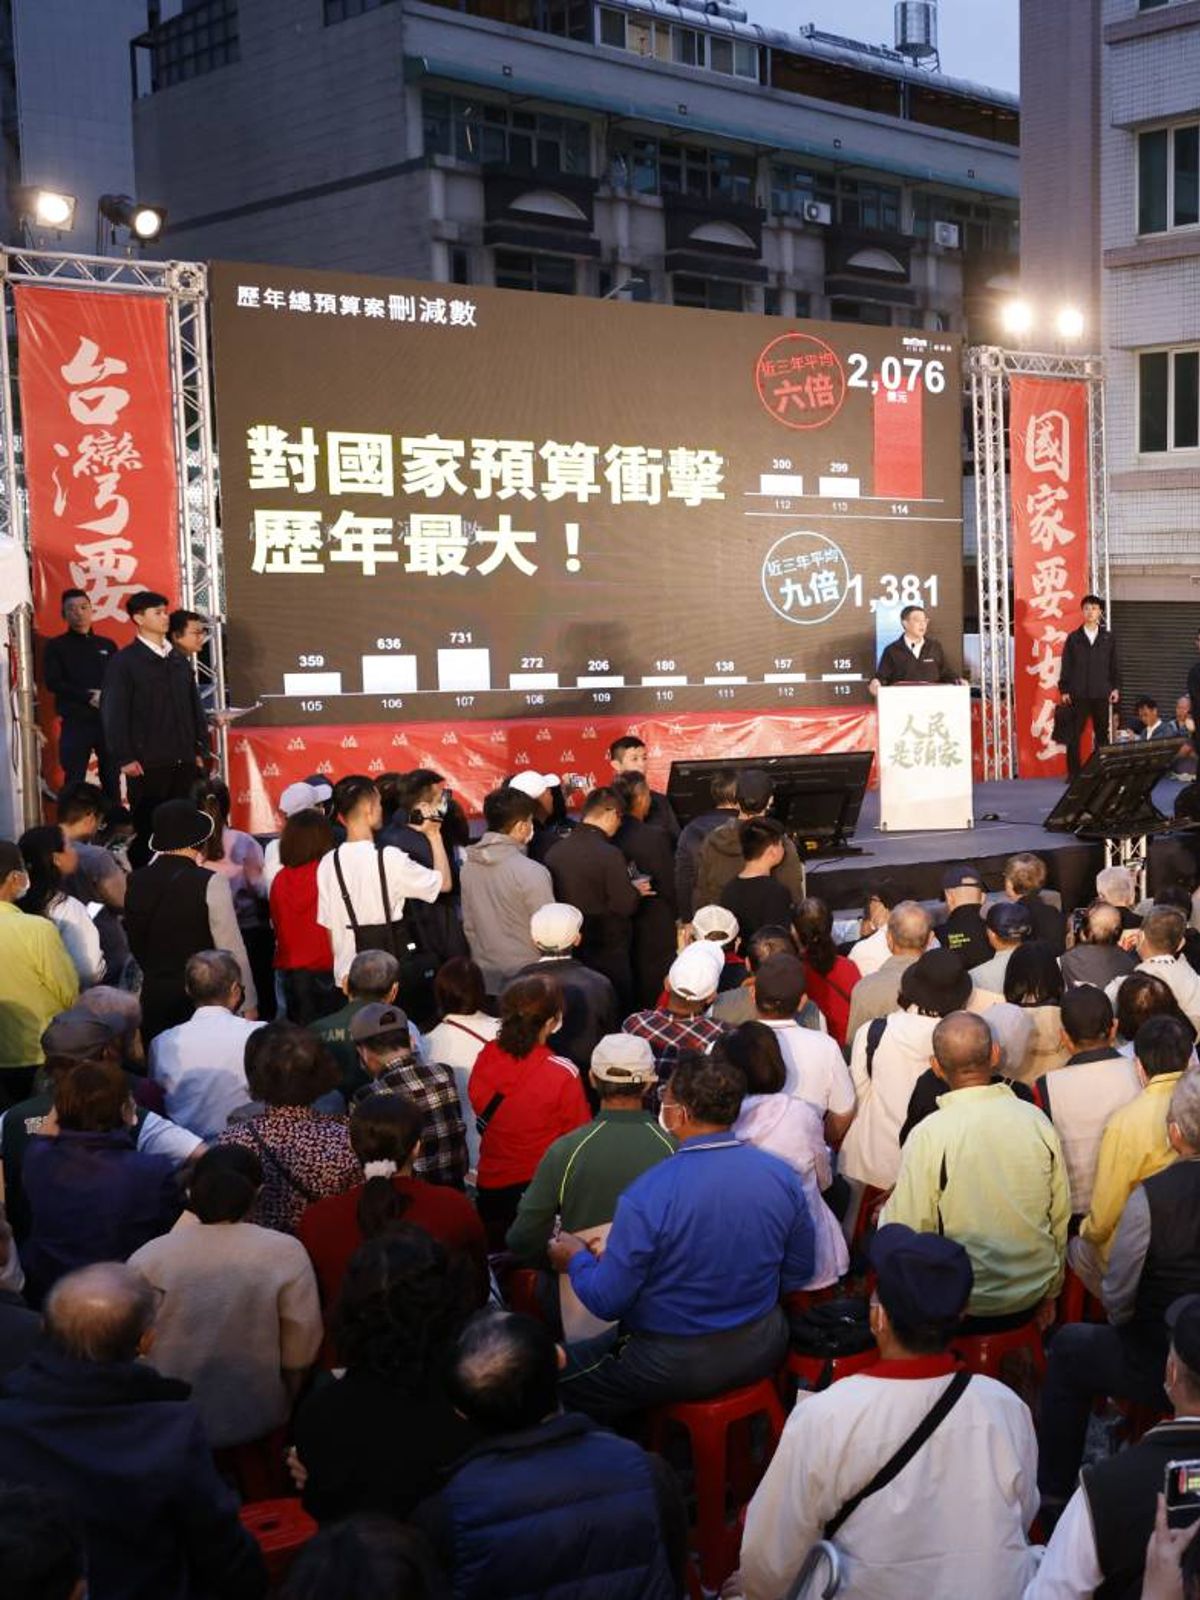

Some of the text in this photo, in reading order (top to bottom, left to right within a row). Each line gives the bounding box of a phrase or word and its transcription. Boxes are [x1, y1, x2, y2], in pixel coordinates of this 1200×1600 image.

[237, 285, 477, 327] 歷年總預算案刪減數
[847, 353, 946, 395] 2,076
[773, 374, 835, 413] 六倍
[246, 424, 726, 507] 對國家預算衝擊
[891, 504, 909, 514] 114
[251, 509, 582, 576] 歷年最大！
[767, 547, 840, 576] 近三年平均
[779, 569, 840, 611] 九倍
[848, 573, 939, 613] 1,381
[377, 638, 401, 650] 636
[450, 632, 473, 644] 731
[299, 656, 324, 667] 359
[521, 657, 544, 668] 272
[588, 660, 609, 671] 206
[774, 659, 793, 669] 157
[456, 696, 474, 707] 107
[593, 692, 611, 703] 109
[656, 690, 674, 701] 110
[301, 701, 322, 712] 105
[381, 698, 402, 709] 106
[900, 711, 950, 739] 人民
